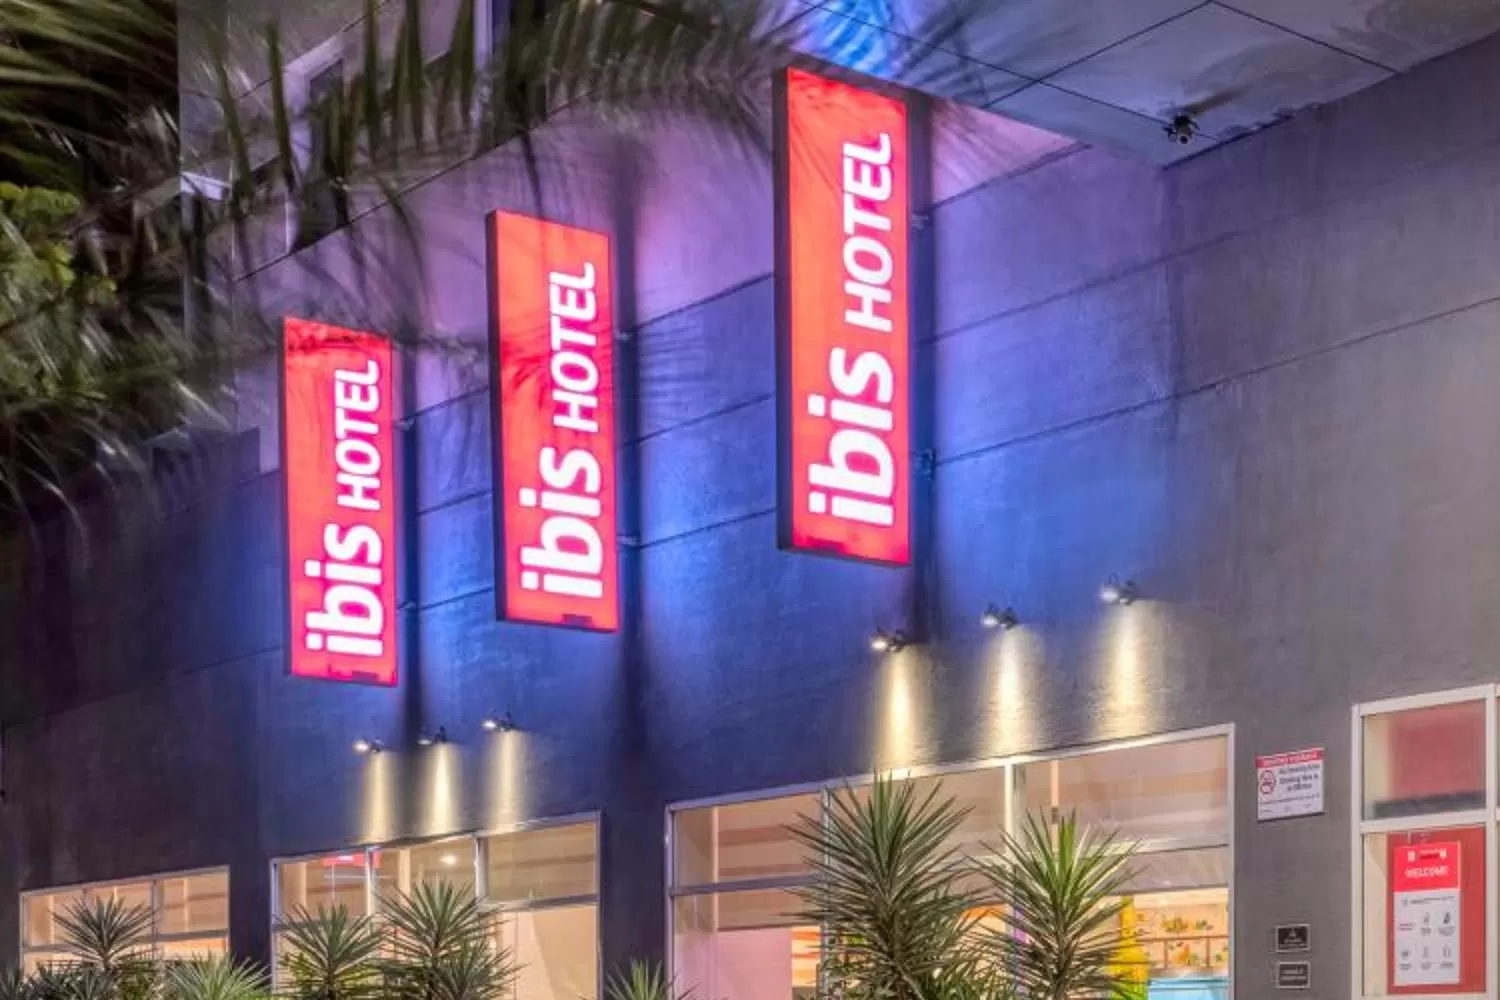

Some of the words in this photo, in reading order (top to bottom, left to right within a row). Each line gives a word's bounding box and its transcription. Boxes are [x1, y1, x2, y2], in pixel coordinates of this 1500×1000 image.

[842, 131, 893, 334] HOTEL
[549, 262, 600, 434] HOTEL
[333, 359, 382, 511] HOTEL
[807, 347, 895, 528] ibis
[304, 522, 384, 657] ibis
[519, 446, 604, 600] ibis
